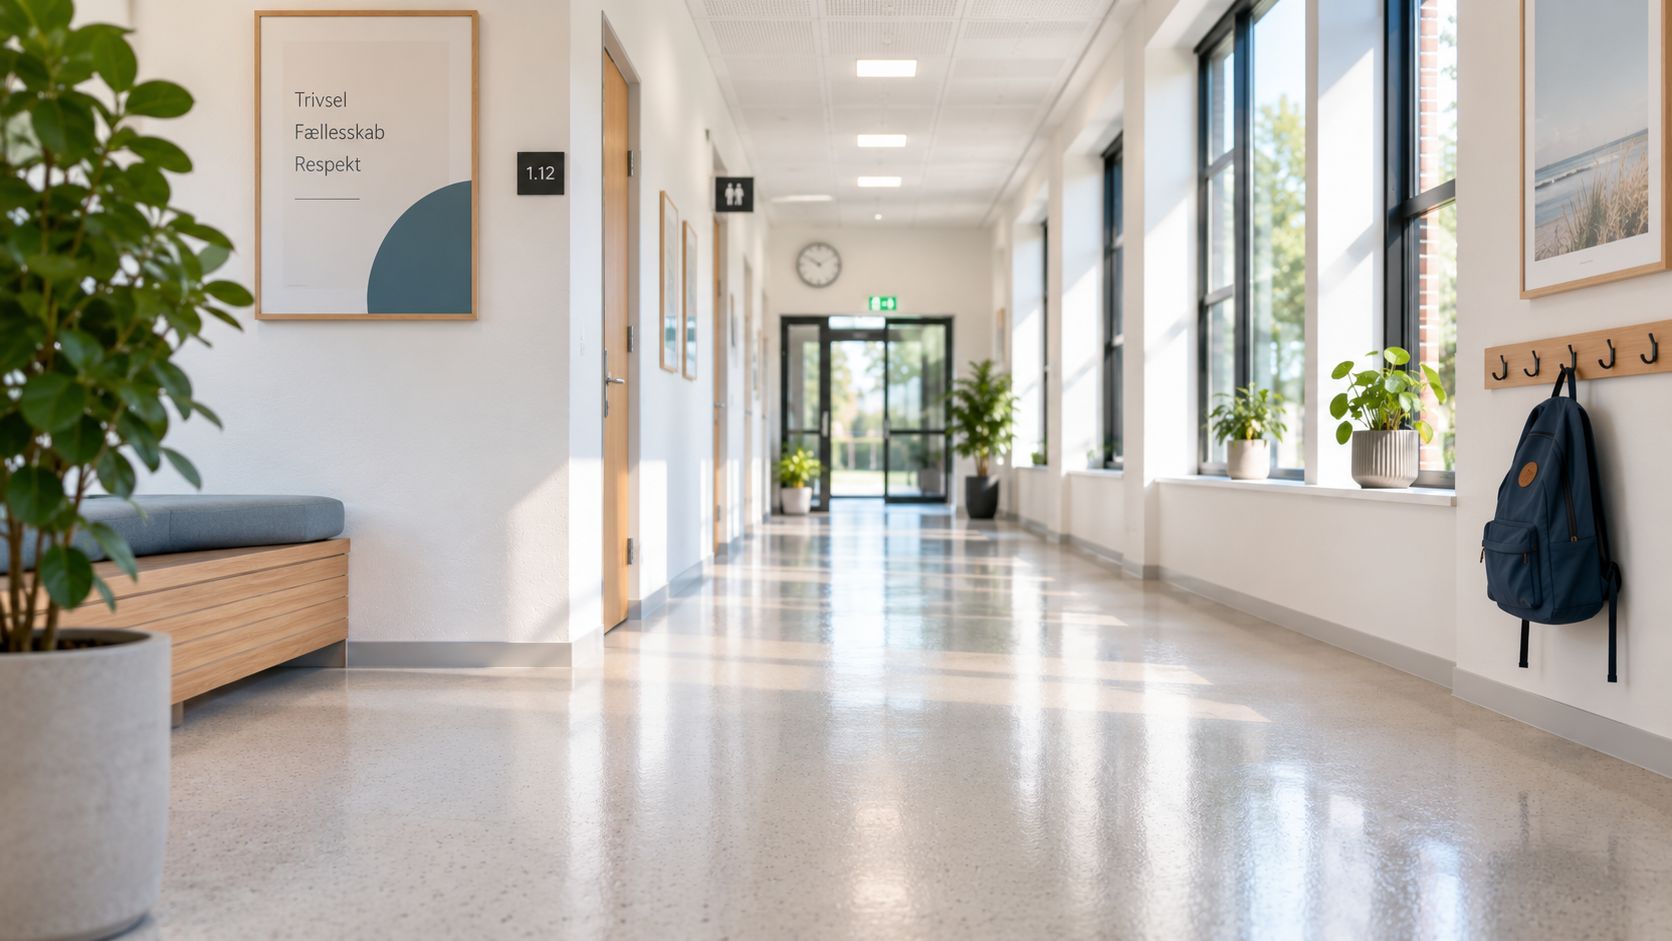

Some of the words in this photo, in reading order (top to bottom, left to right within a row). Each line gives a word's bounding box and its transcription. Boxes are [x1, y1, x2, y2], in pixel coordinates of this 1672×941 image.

[294, 90, 348, 109] Trivsel
[294, 123, 386, 141] Fællesskab
[294, 155, 362, 177] Respekt
[526, 165, 555, 181] 1.12
